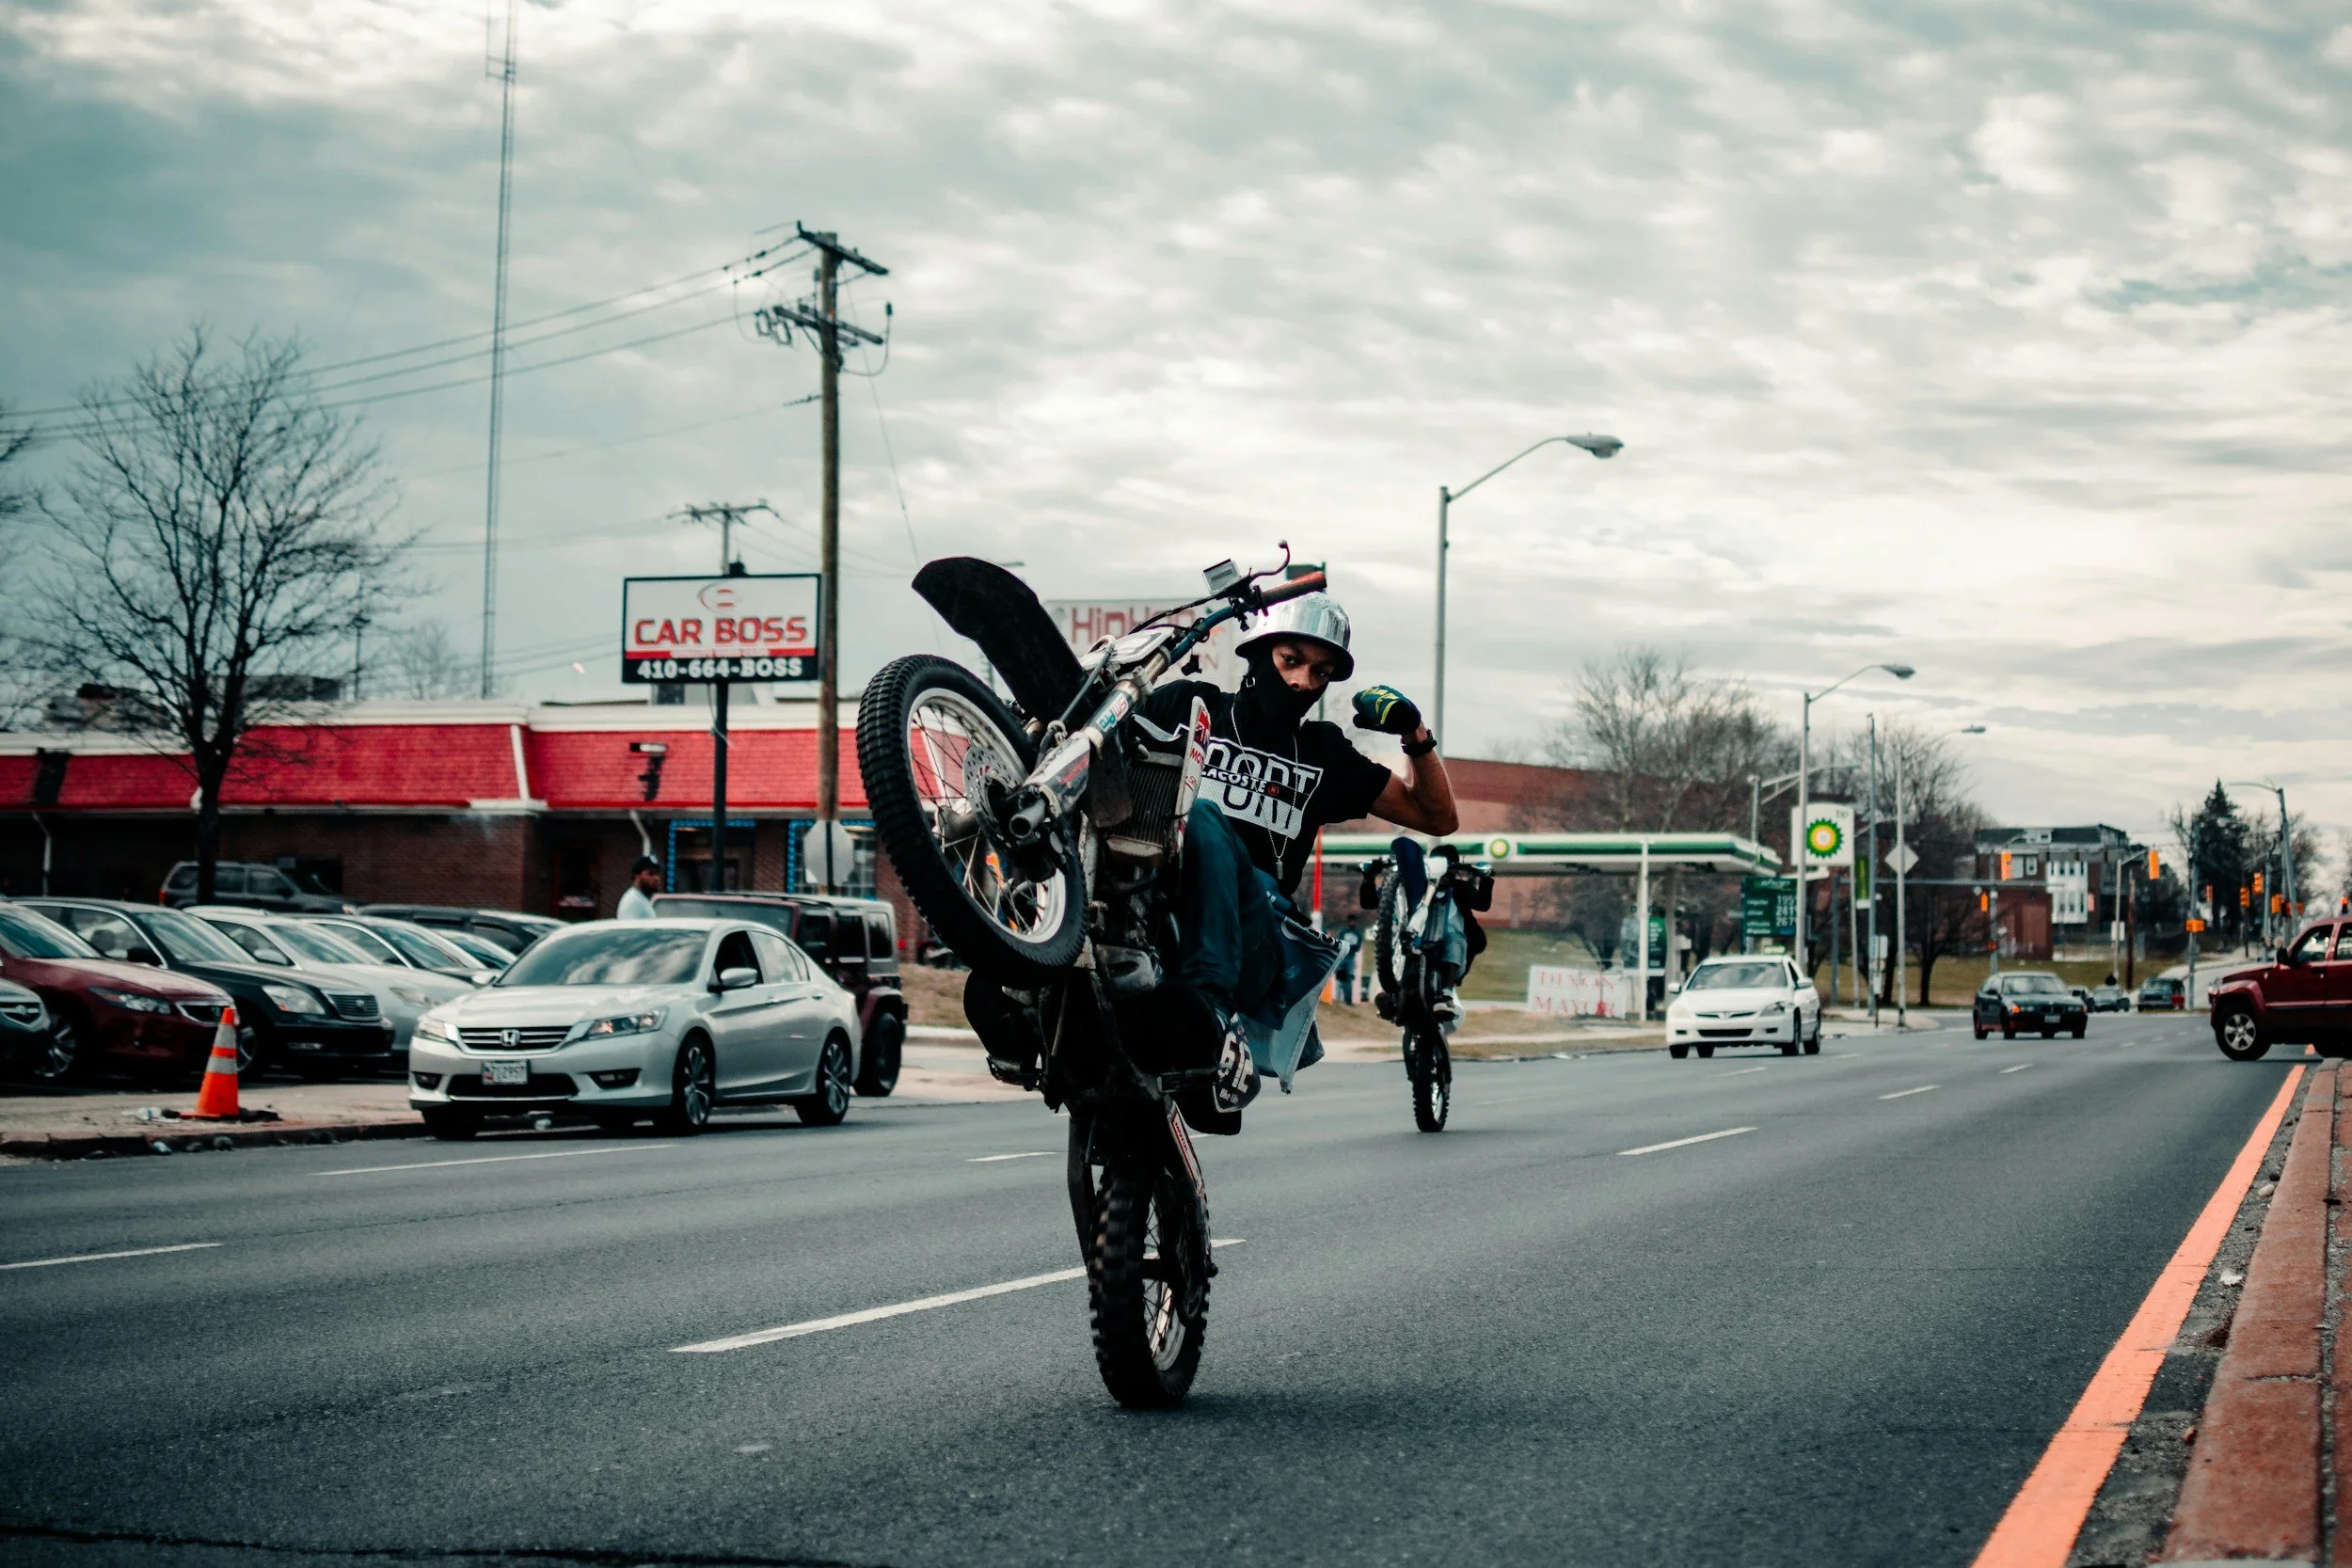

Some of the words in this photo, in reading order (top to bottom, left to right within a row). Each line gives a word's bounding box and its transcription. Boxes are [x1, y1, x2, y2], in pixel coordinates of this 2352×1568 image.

[634, 617, 702, 646] CAR
[715, 615, 808, 646] BOSS
[637, 657, 803, 679] 410-664-BOSS
[1836, 809, 1850, 819] bp
